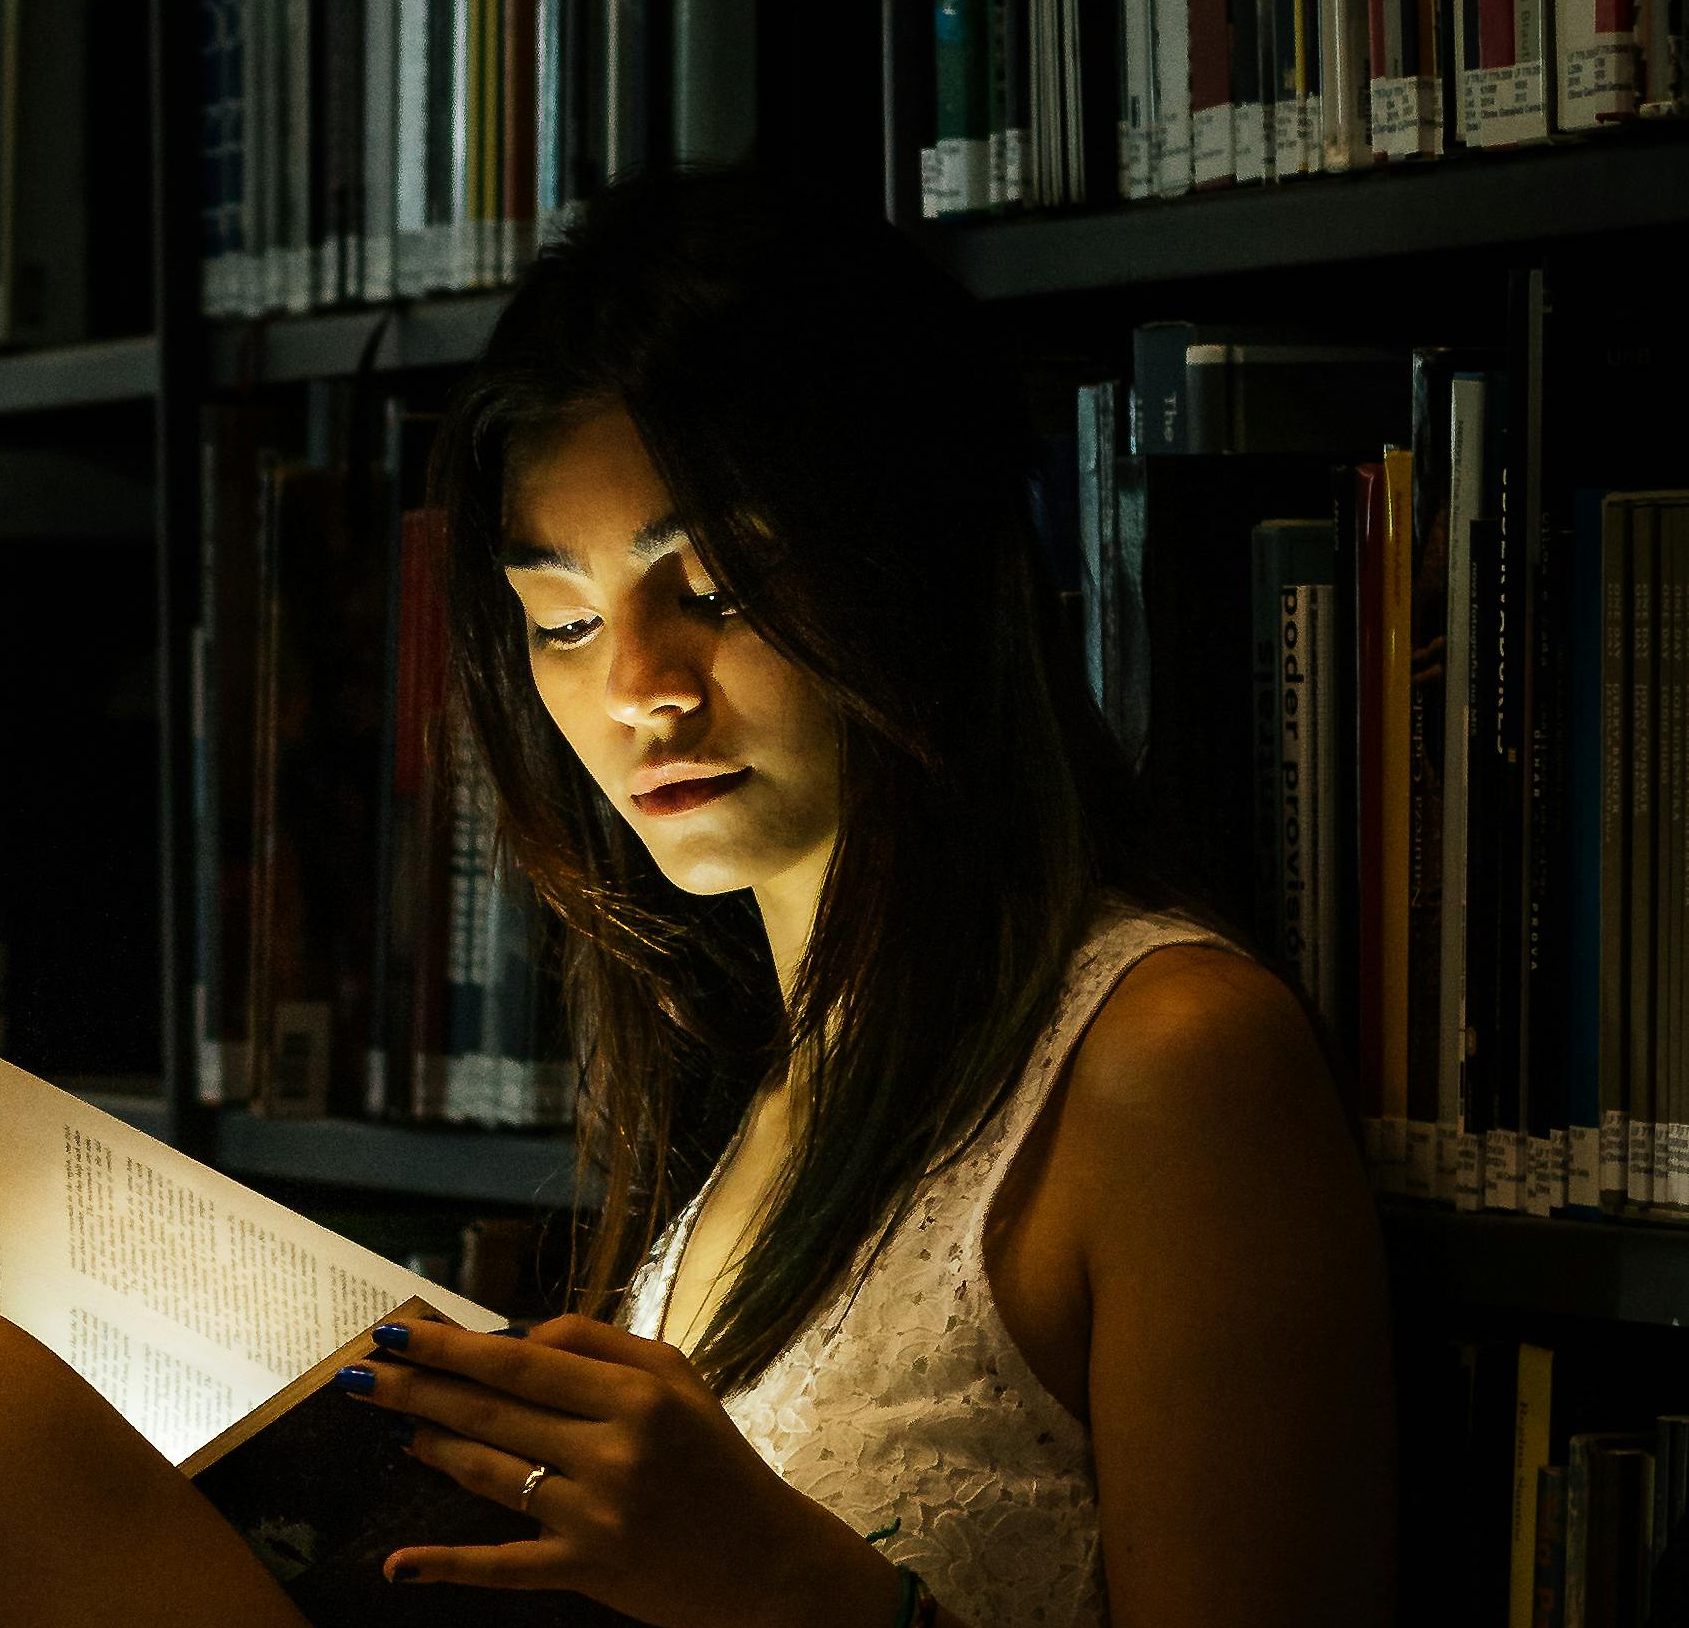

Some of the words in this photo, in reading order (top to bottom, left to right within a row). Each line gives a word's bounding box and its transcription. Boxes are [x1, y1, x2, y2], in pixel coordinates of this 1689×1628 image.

[1281, 588, 1304, 740] poder
[1411, 690, 1424, 782] Cidade
[1281, 762, 1306, 954] provisó
